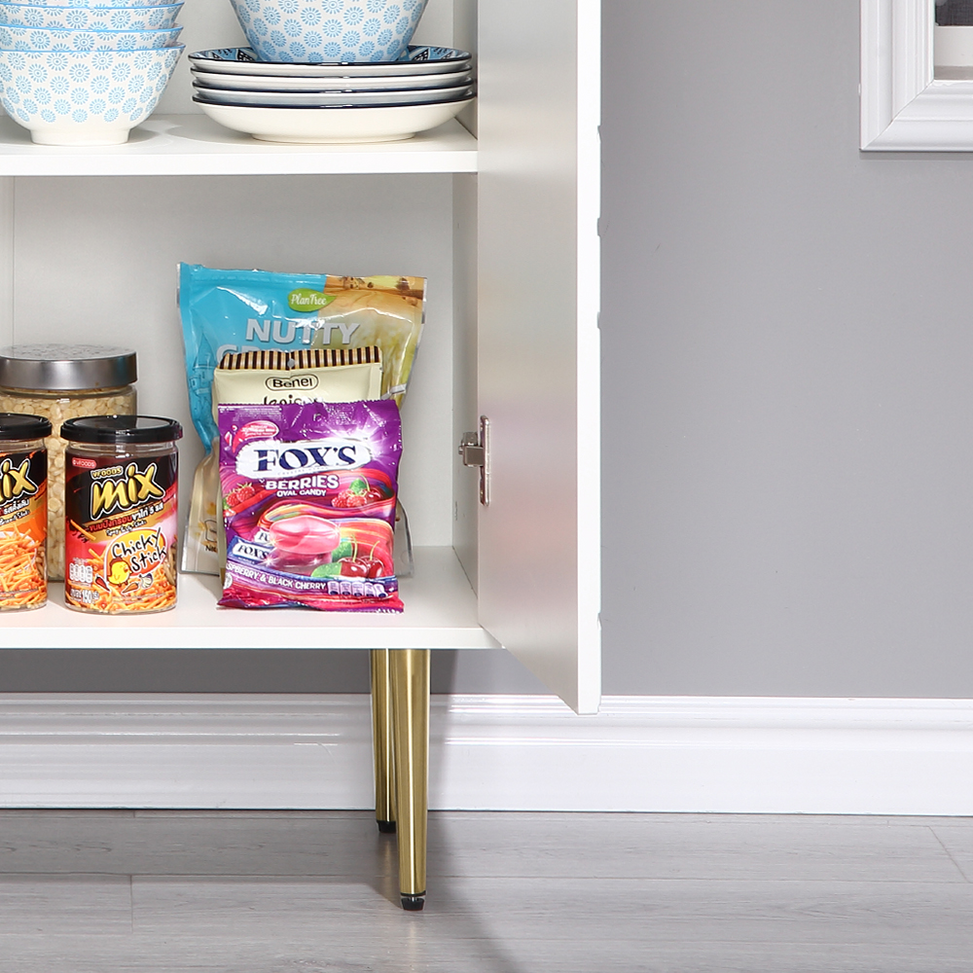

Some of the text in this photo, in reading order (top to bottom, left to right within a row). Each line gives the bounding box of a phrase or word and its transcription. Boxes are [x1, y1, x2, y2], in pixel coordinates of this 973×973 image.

[245, 318, 360, 345] NUTTY
[253, 445, 357, 472] FOX'S
[92, 464, 164, 518] mix
[266, 475, 340, 490] BERRIES
[277, 489, 327, 498] OVAL CANDY
[112, 527, 161, 557] Chicky
[131, 545, 166, 572] Stick
[226, 563, 259, 580] SPBERRY
[268, 576, 294, 588] BLACK
[294, 581, 327, 590] CHERRY
